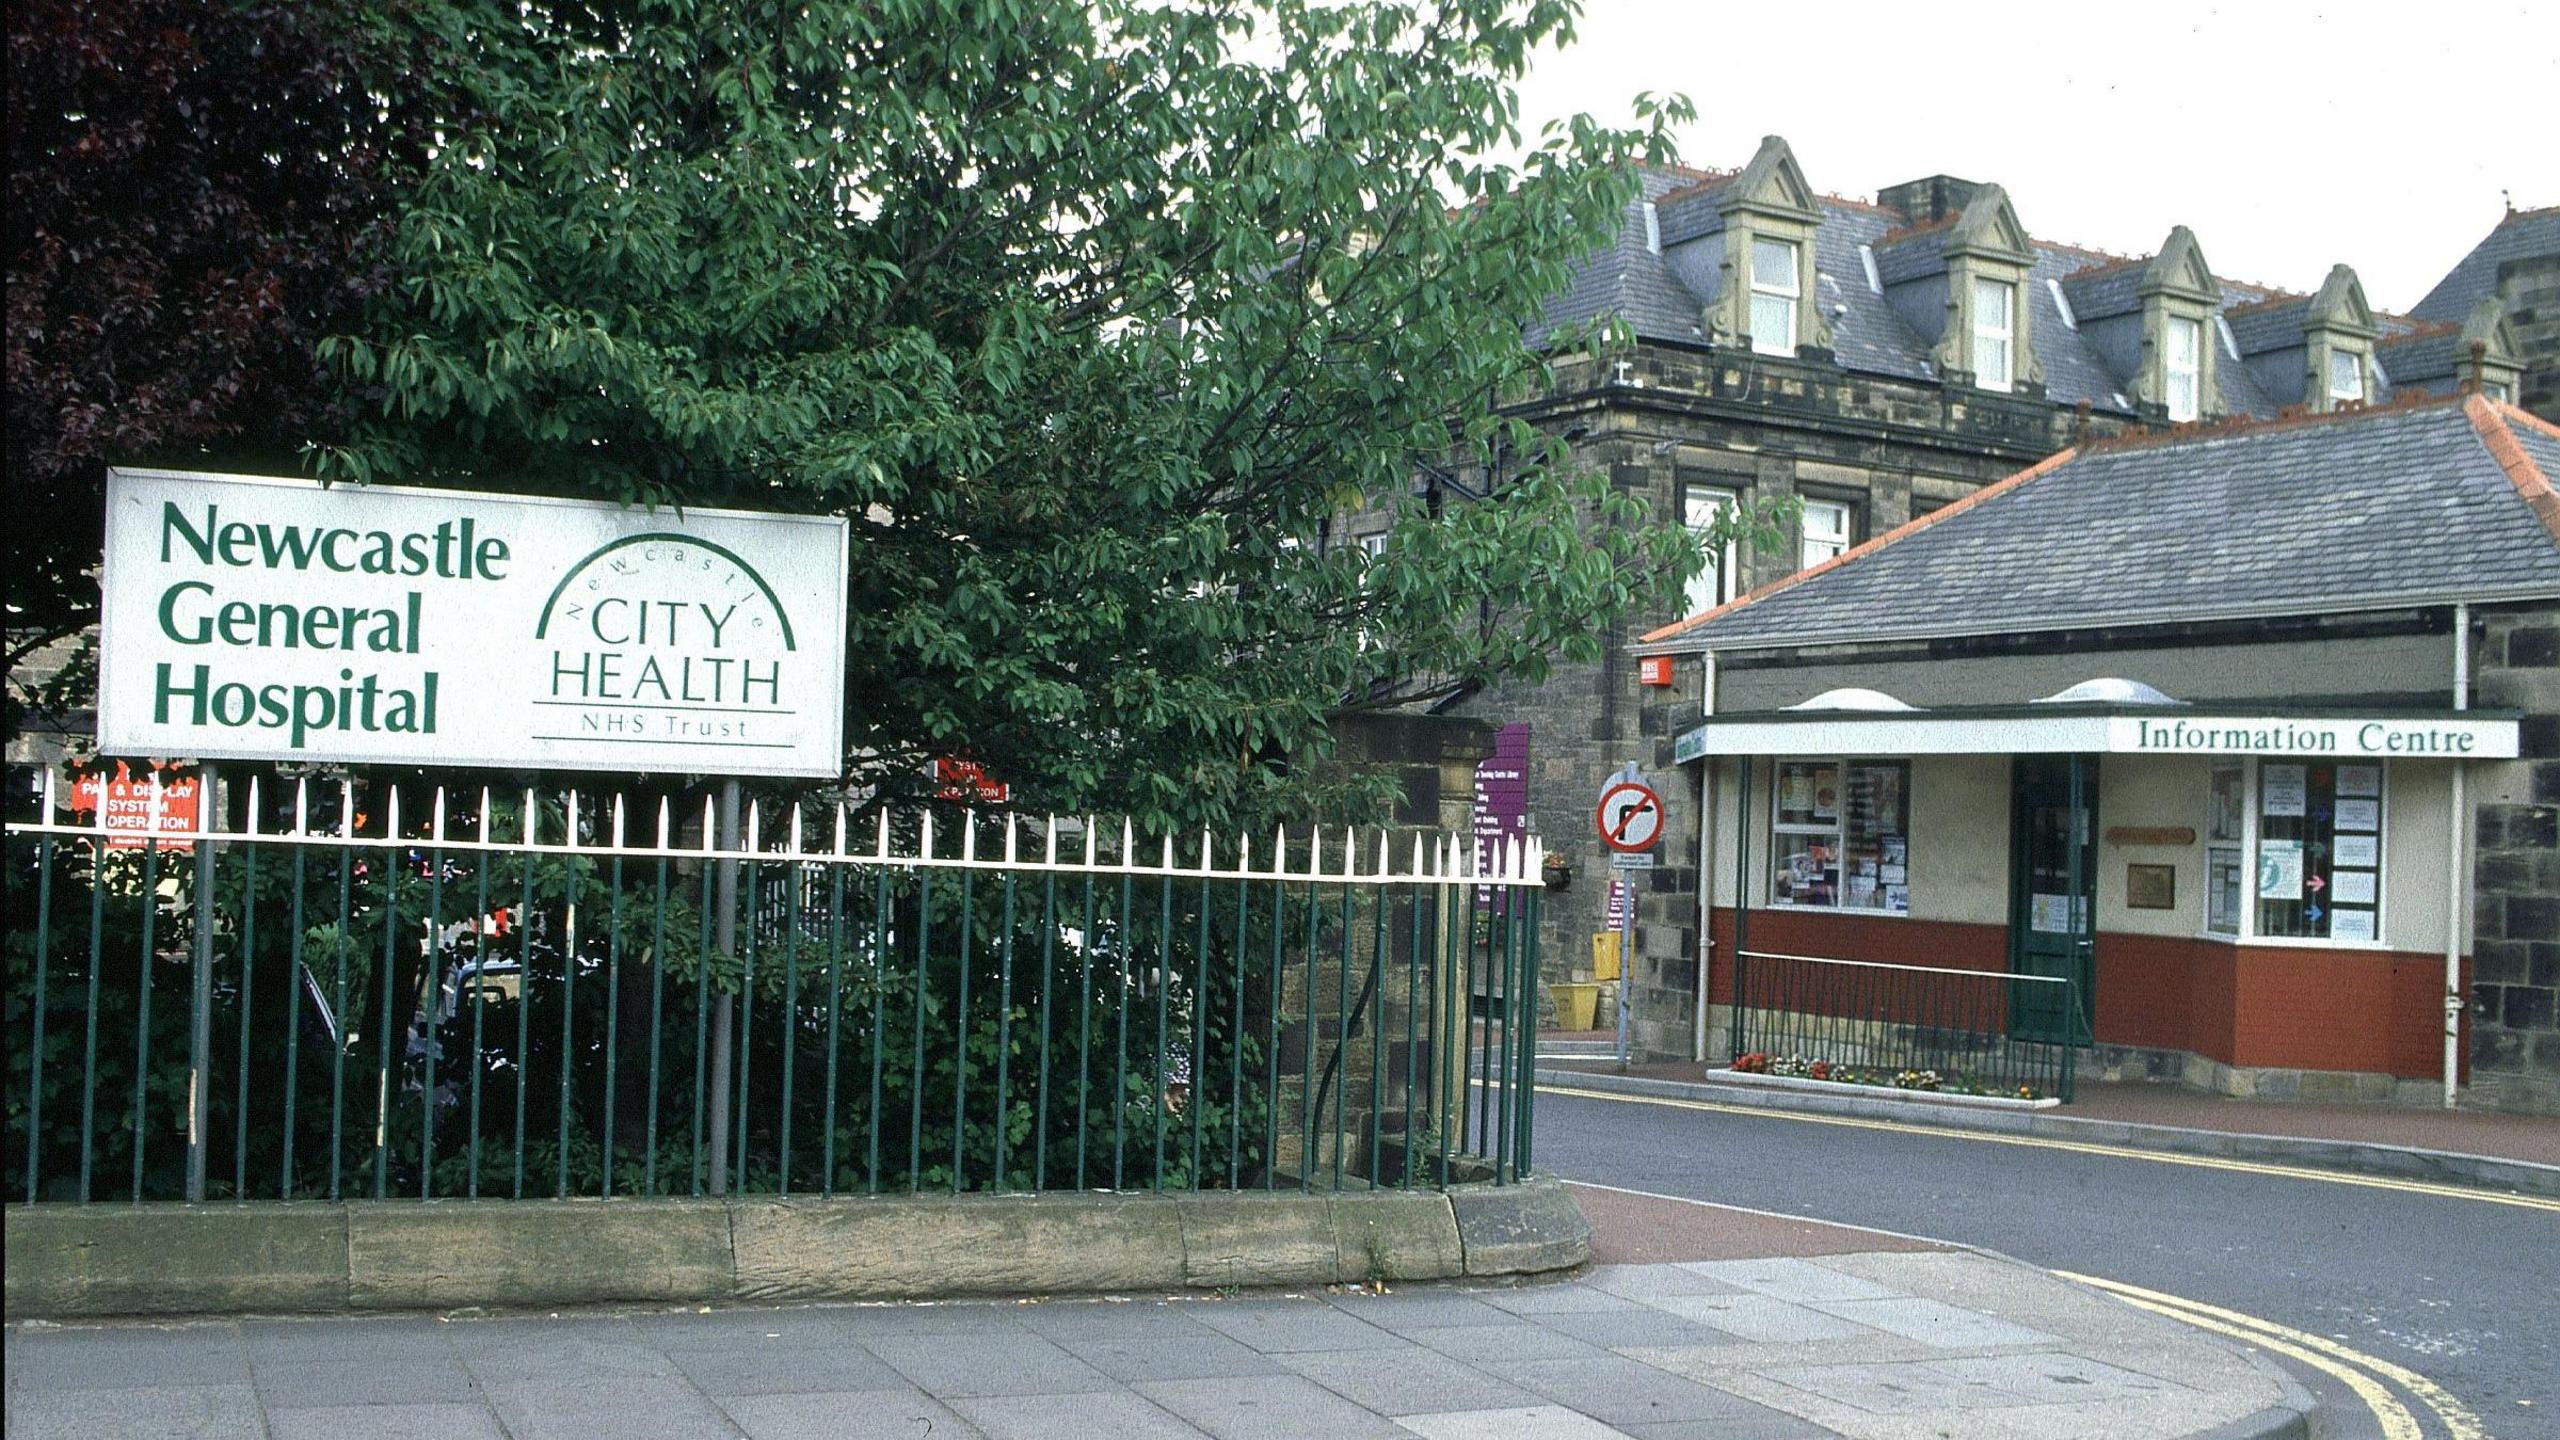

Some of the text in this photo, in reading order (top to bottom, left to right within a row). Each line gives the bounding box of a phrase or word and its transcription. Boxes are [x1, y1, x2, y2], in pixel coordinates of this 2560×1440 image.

[160, 501, 510, 581] Newcastle
[158, 580, 423, 654] General
[592, 597, 738, 649] CITY
[553, 650, 780, 705] HEALTH
[154, 662, 440, 749] Hospital
[582, 713, 749, 736] NHS Trust
[2139, 720, 2474, 753] Information Centre
[82, 783, 106, 796] PA
[115, 784, 126, 797] &
